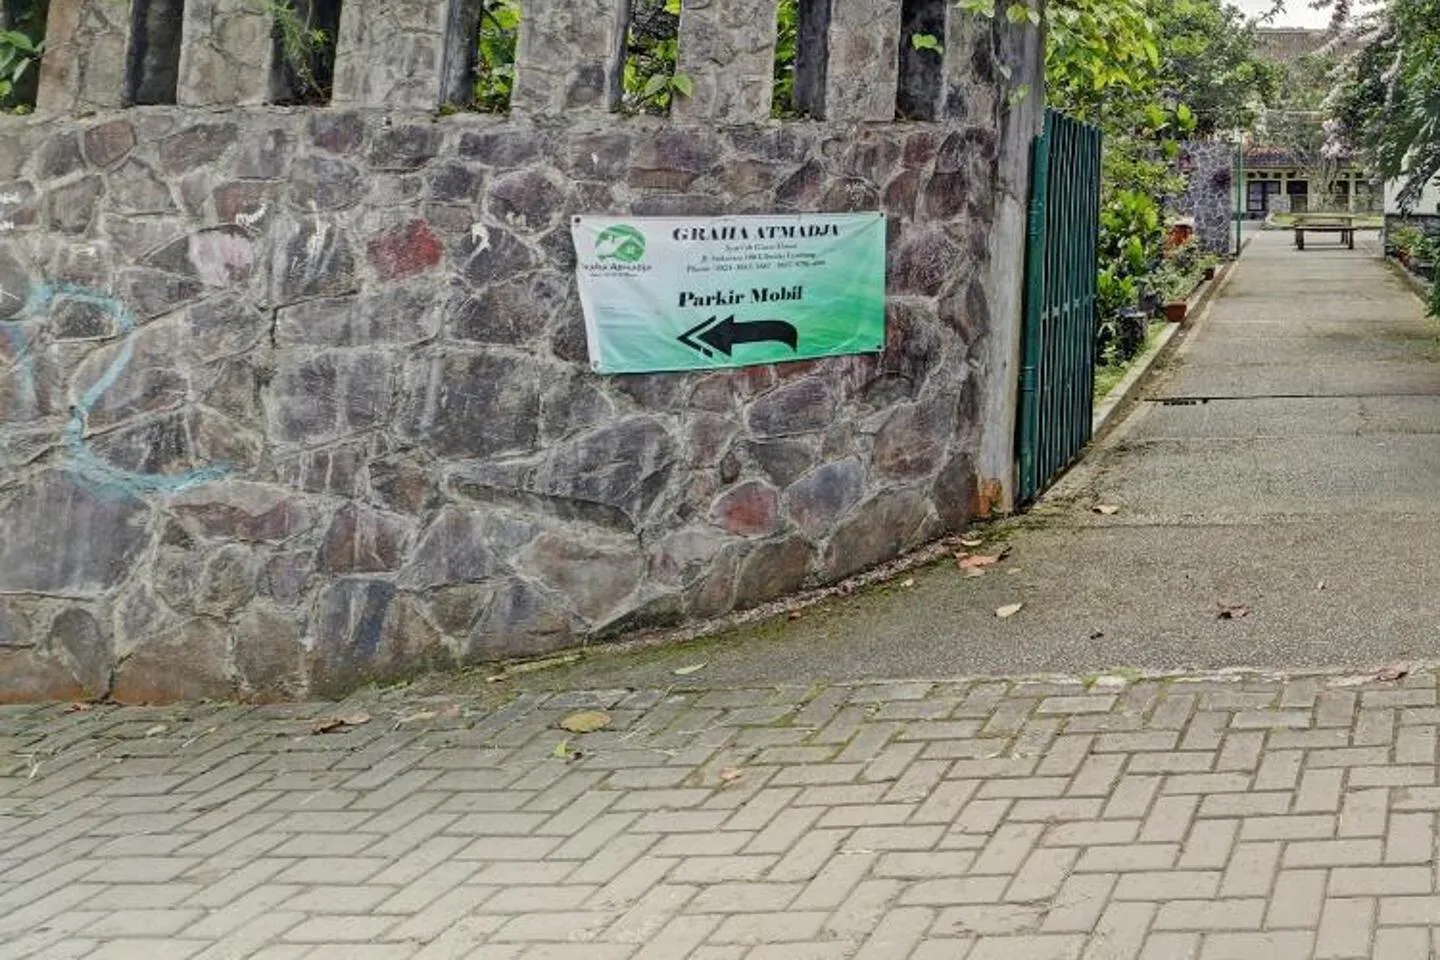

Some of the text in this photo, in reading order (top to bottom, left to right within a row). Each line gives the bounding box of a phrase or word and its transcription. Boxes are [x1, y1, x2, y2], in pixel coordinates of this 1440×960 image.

[673, 224, 839, 241] GRAHA ATMADJA
[678, 286, 803, 307] Parkir Mobil
